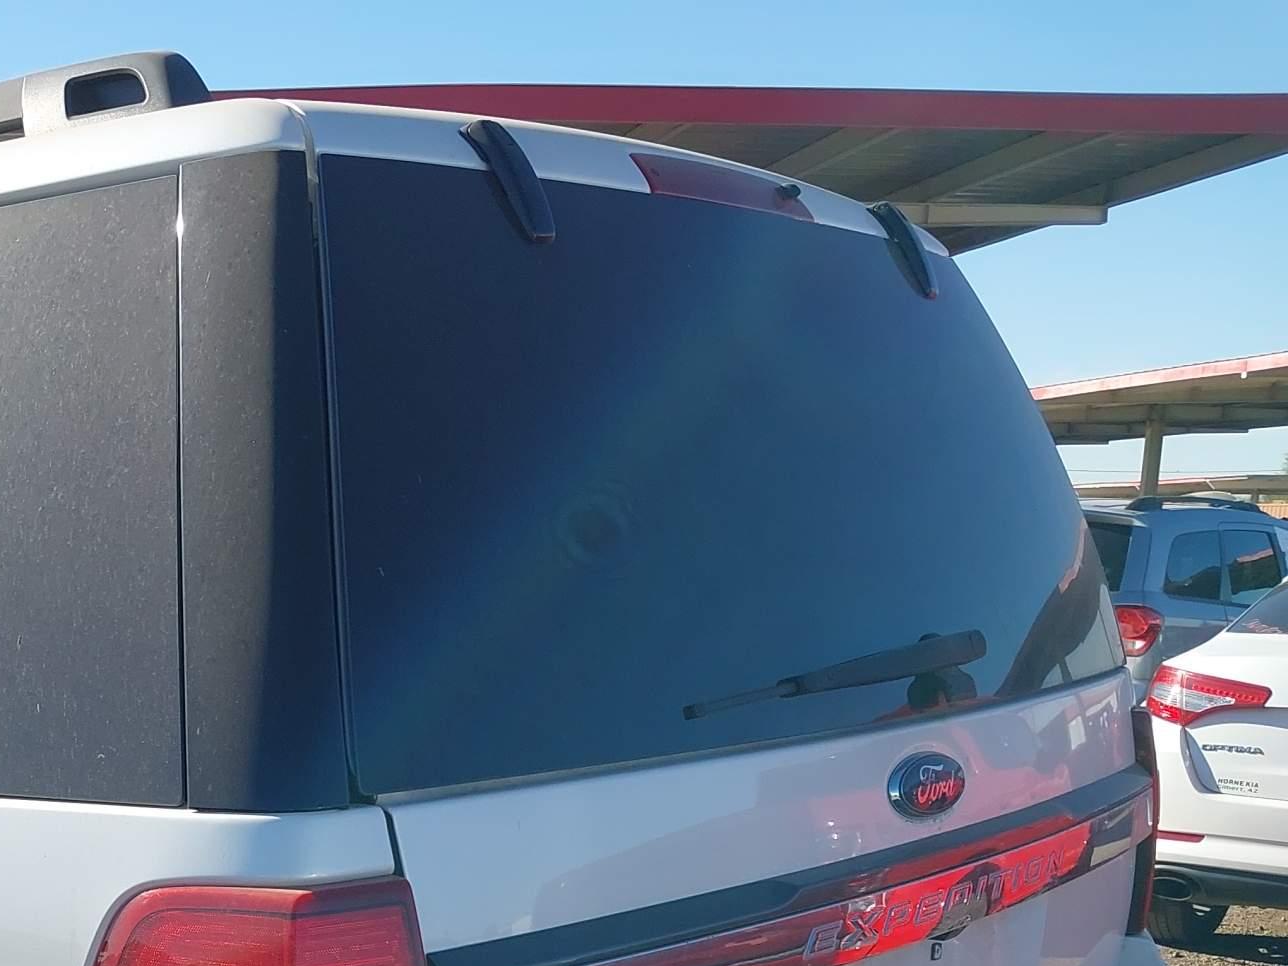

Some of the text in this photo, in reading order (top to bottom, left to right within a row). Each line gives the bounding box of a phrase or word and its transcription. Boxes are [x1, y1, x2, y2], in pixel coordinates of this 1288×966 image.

[1202, 744, 1264, 756] OPTIMA
[917, 764, 955, 804] Ford
[803, 848, 1064, 961] EXPEDITION
